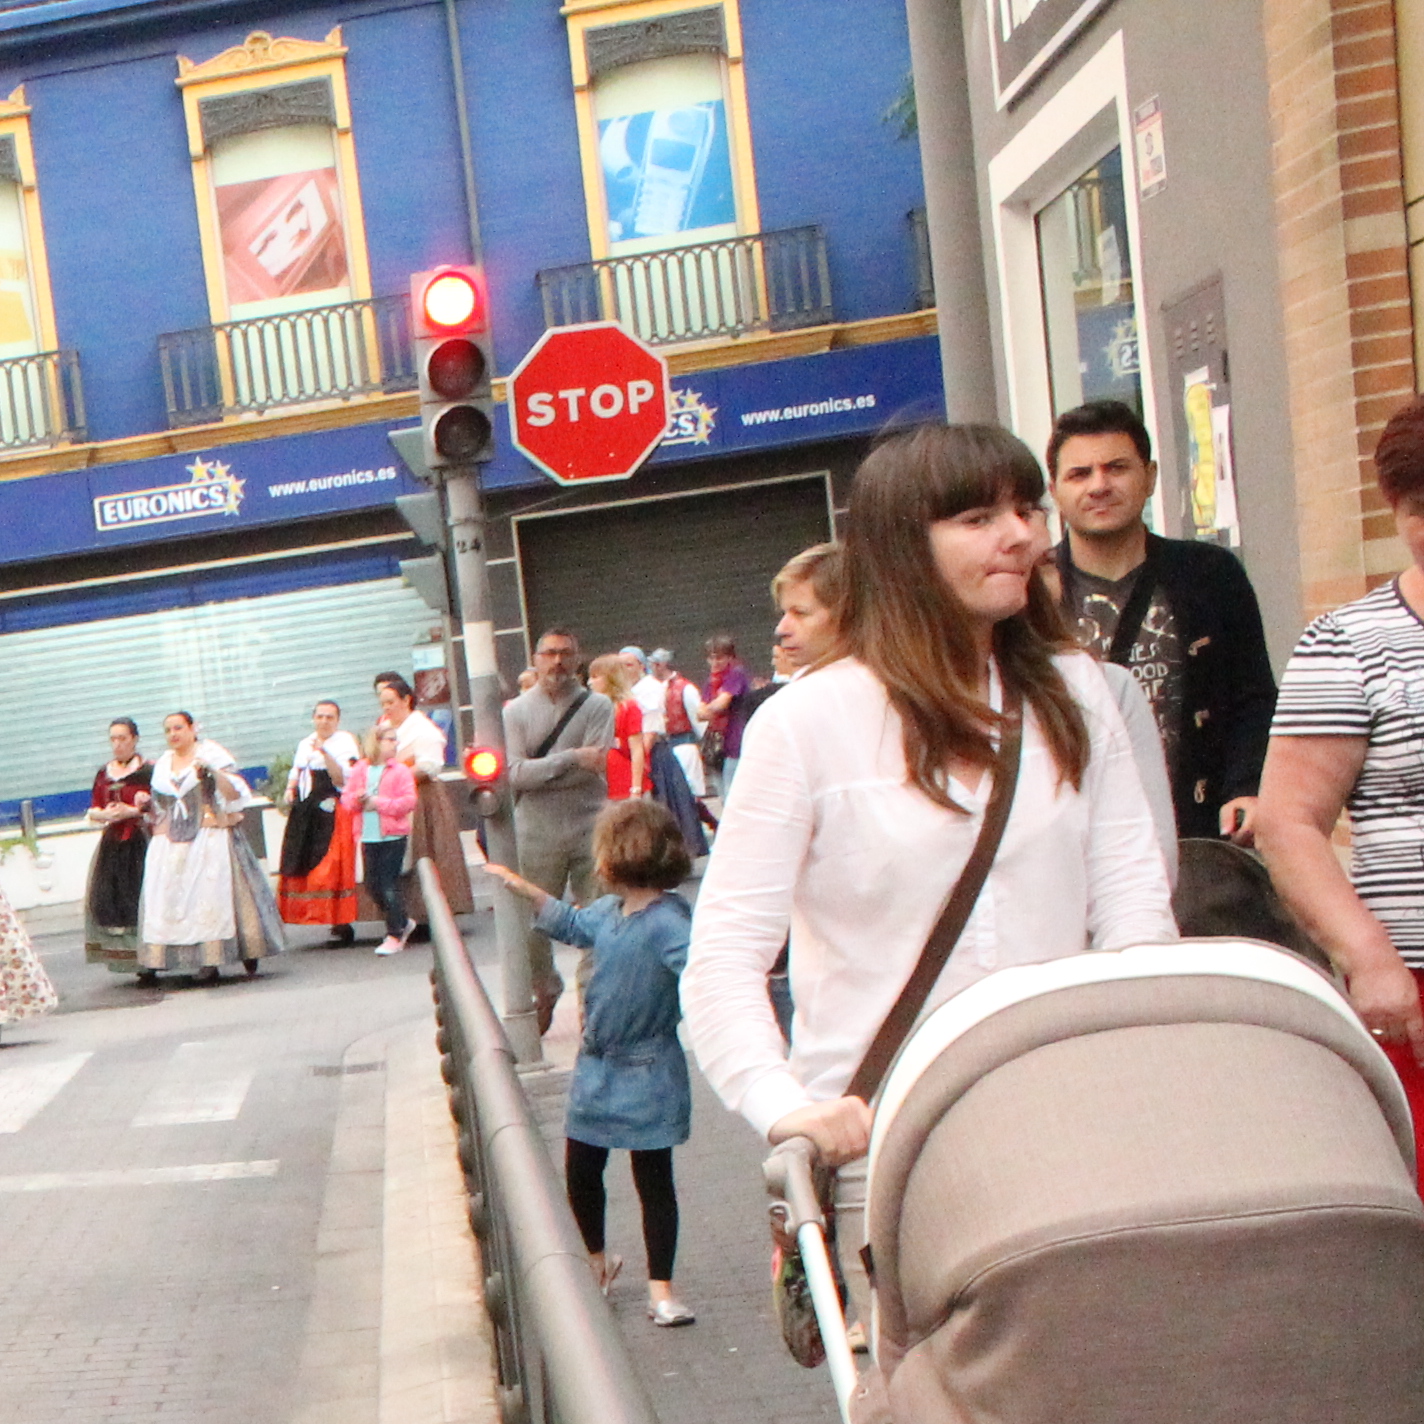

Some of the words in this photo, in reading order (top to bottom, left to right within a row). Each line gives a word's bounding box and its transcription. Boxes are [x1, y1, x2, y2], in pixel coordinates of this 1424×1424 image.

[526, 379, 654, 427] STOP
[740, 393, 876, 426] www.euronics.es
[268, 465, 397, 498] www.euronics.es
[102, 484, 224, 524] EURONICS
